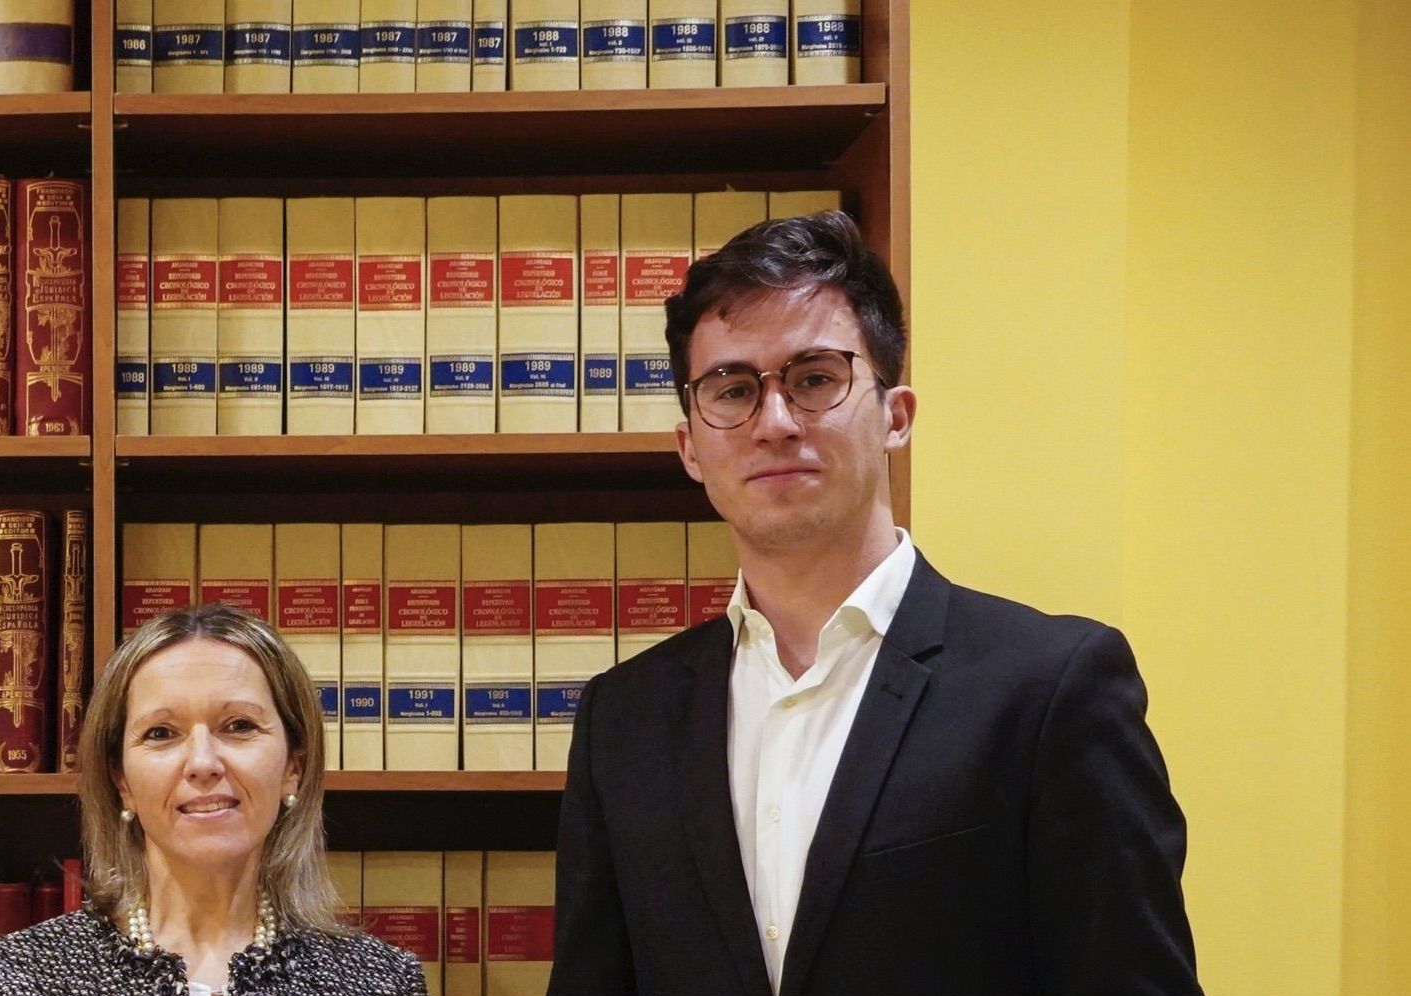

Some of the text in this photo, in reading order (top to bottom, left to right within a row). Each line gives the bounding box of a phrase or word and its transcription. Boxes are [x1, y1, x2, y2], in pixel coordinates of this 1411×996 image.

[671, 24, 698, 34] 1988
[744, 23, 770, 34] 1988
[817, 21, 845, 32] 1988
[375, 32, 402, 42] 1987
[431, 32, 457, 42] 1987
[532, 30, 560, 42] 1988
[602, 26, 629, 38] 1988
[175, 34, 201, 45] 1987
[244, 33, 271, 44] 1987
[314, 33, 340, 44] 1987
[478, 38, 501, 48] 1987
[122, 40, 146, 50] 1986
[171, 363, 198, 374] 1989
[238, 363, 264, 374] 1989
[308, 364, 335, 374] 1989
[378, 364, 404, 374] 1989
[449, 362, 476, 372] 1989
[524, 361, 551, 371] 1989
[643, 360, 669, 370] 1990
[122, 372, 145, 383] 1988
[589, 368, 612, 378] 1989
[398, 608, 448, 616] CRONOLÓGICO
[408, 690, 434, 700] 1991
[488, 690, 510, 700] 1991
[350, 698, 374, 708] 1990
[8, 750, 27, 760] 1955
